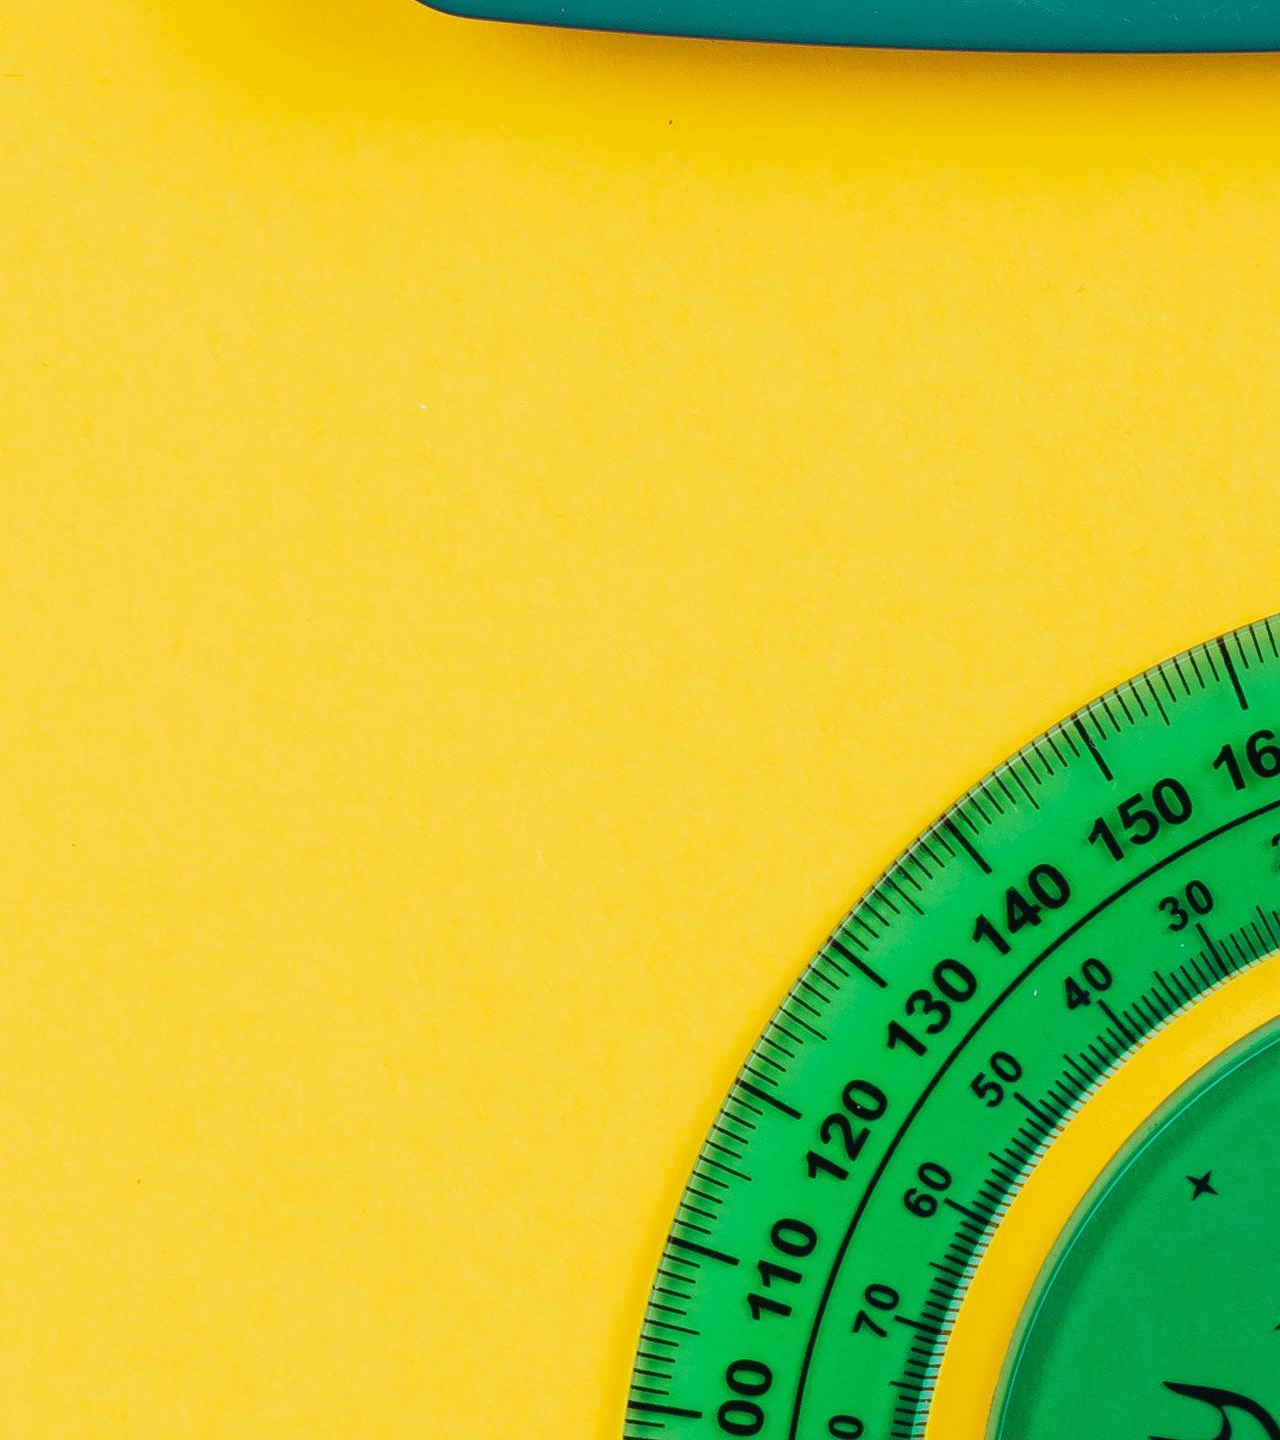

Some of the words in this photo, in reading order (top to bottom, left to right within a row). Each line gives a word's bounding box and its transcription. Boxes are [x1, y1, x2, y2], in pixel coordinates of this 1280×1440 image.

[745, 1217, 819, 1322] 110
[804, 1078, 889, 1182] 120
[886, 957, 979, 1058] 130
[971, 862, 1072, 956] 140
[1086, 776, 1194, 863] 150
[851, 1282, 901, 1339] 70
[902, 1160, 953, 1220] 60
[969, 1050, 1024, 1109] 50
[1063, 956, 1114, 1012] 40
[1157, 879, 1215, 933] 30
